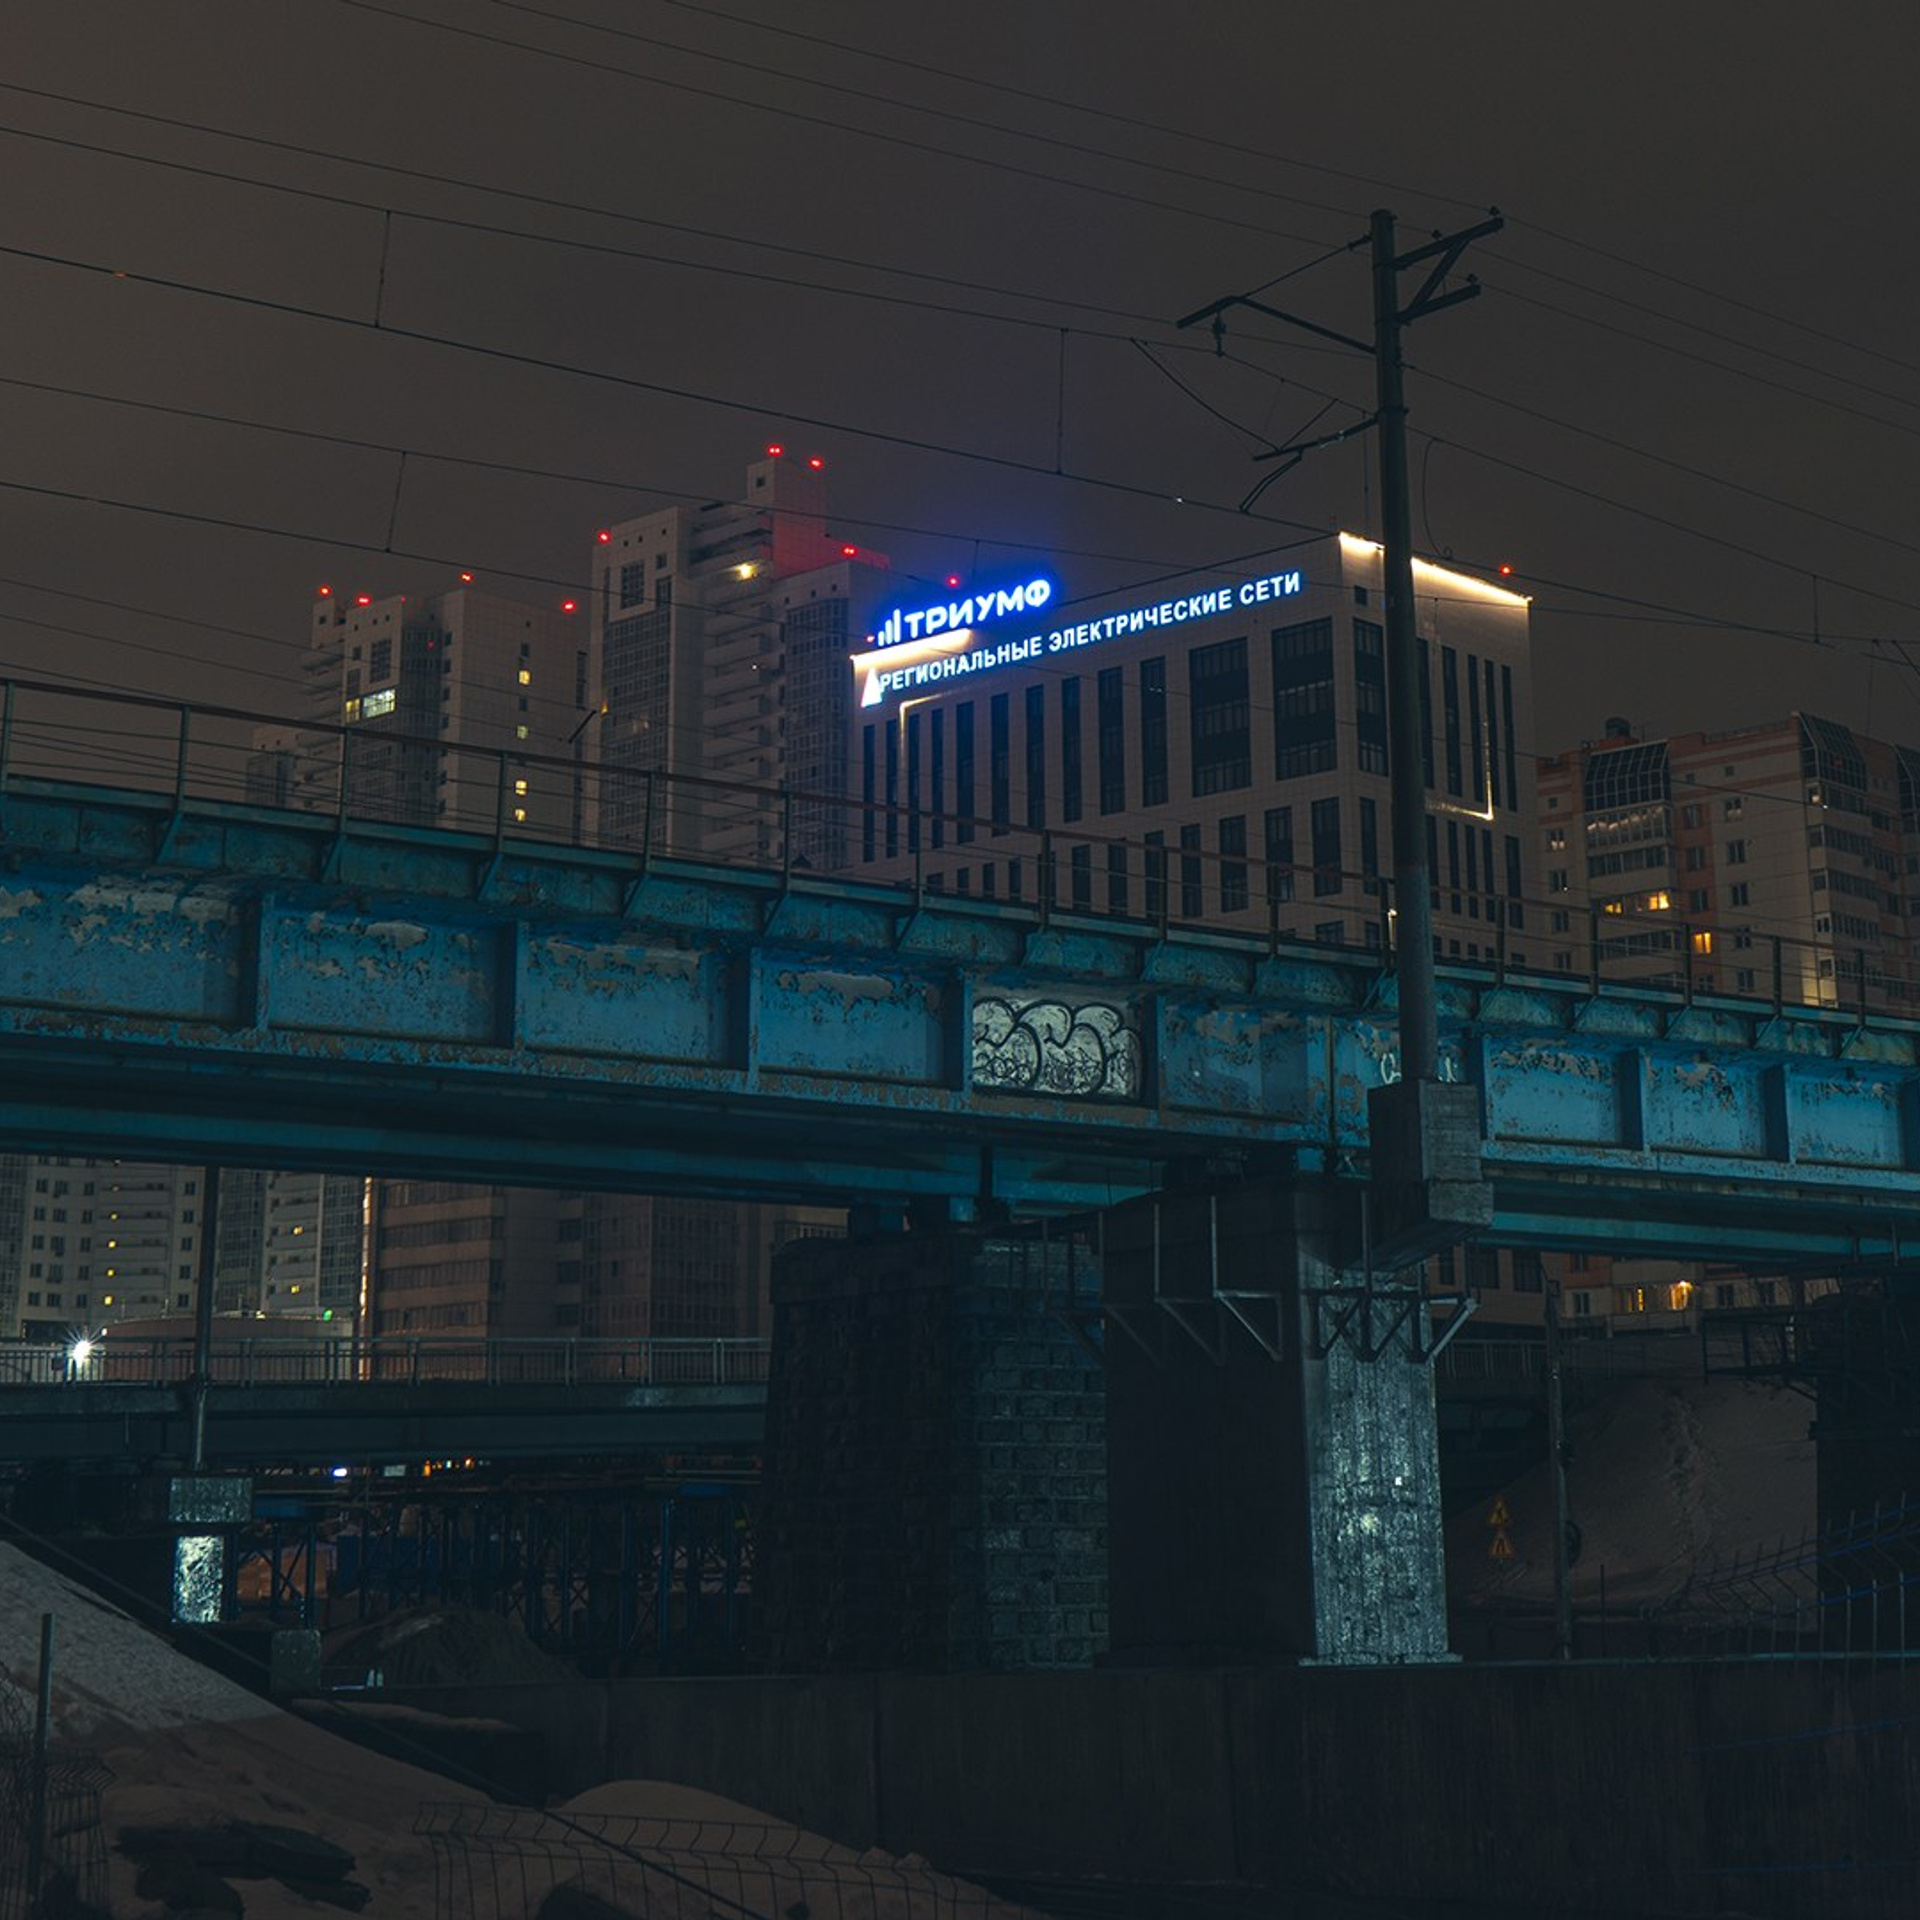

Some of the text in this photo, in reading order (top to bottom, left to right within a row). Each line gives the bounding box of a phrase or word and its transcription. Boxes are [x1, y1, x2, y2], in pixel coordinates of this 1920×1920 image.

[879, 571, 1300, 693] РЕГИОНАЛЬНЫЕ ЭЛЕКТРИЧЕСКИЕ СЕТИ
[904, 579, 1051, 638] ТРИУМФ
